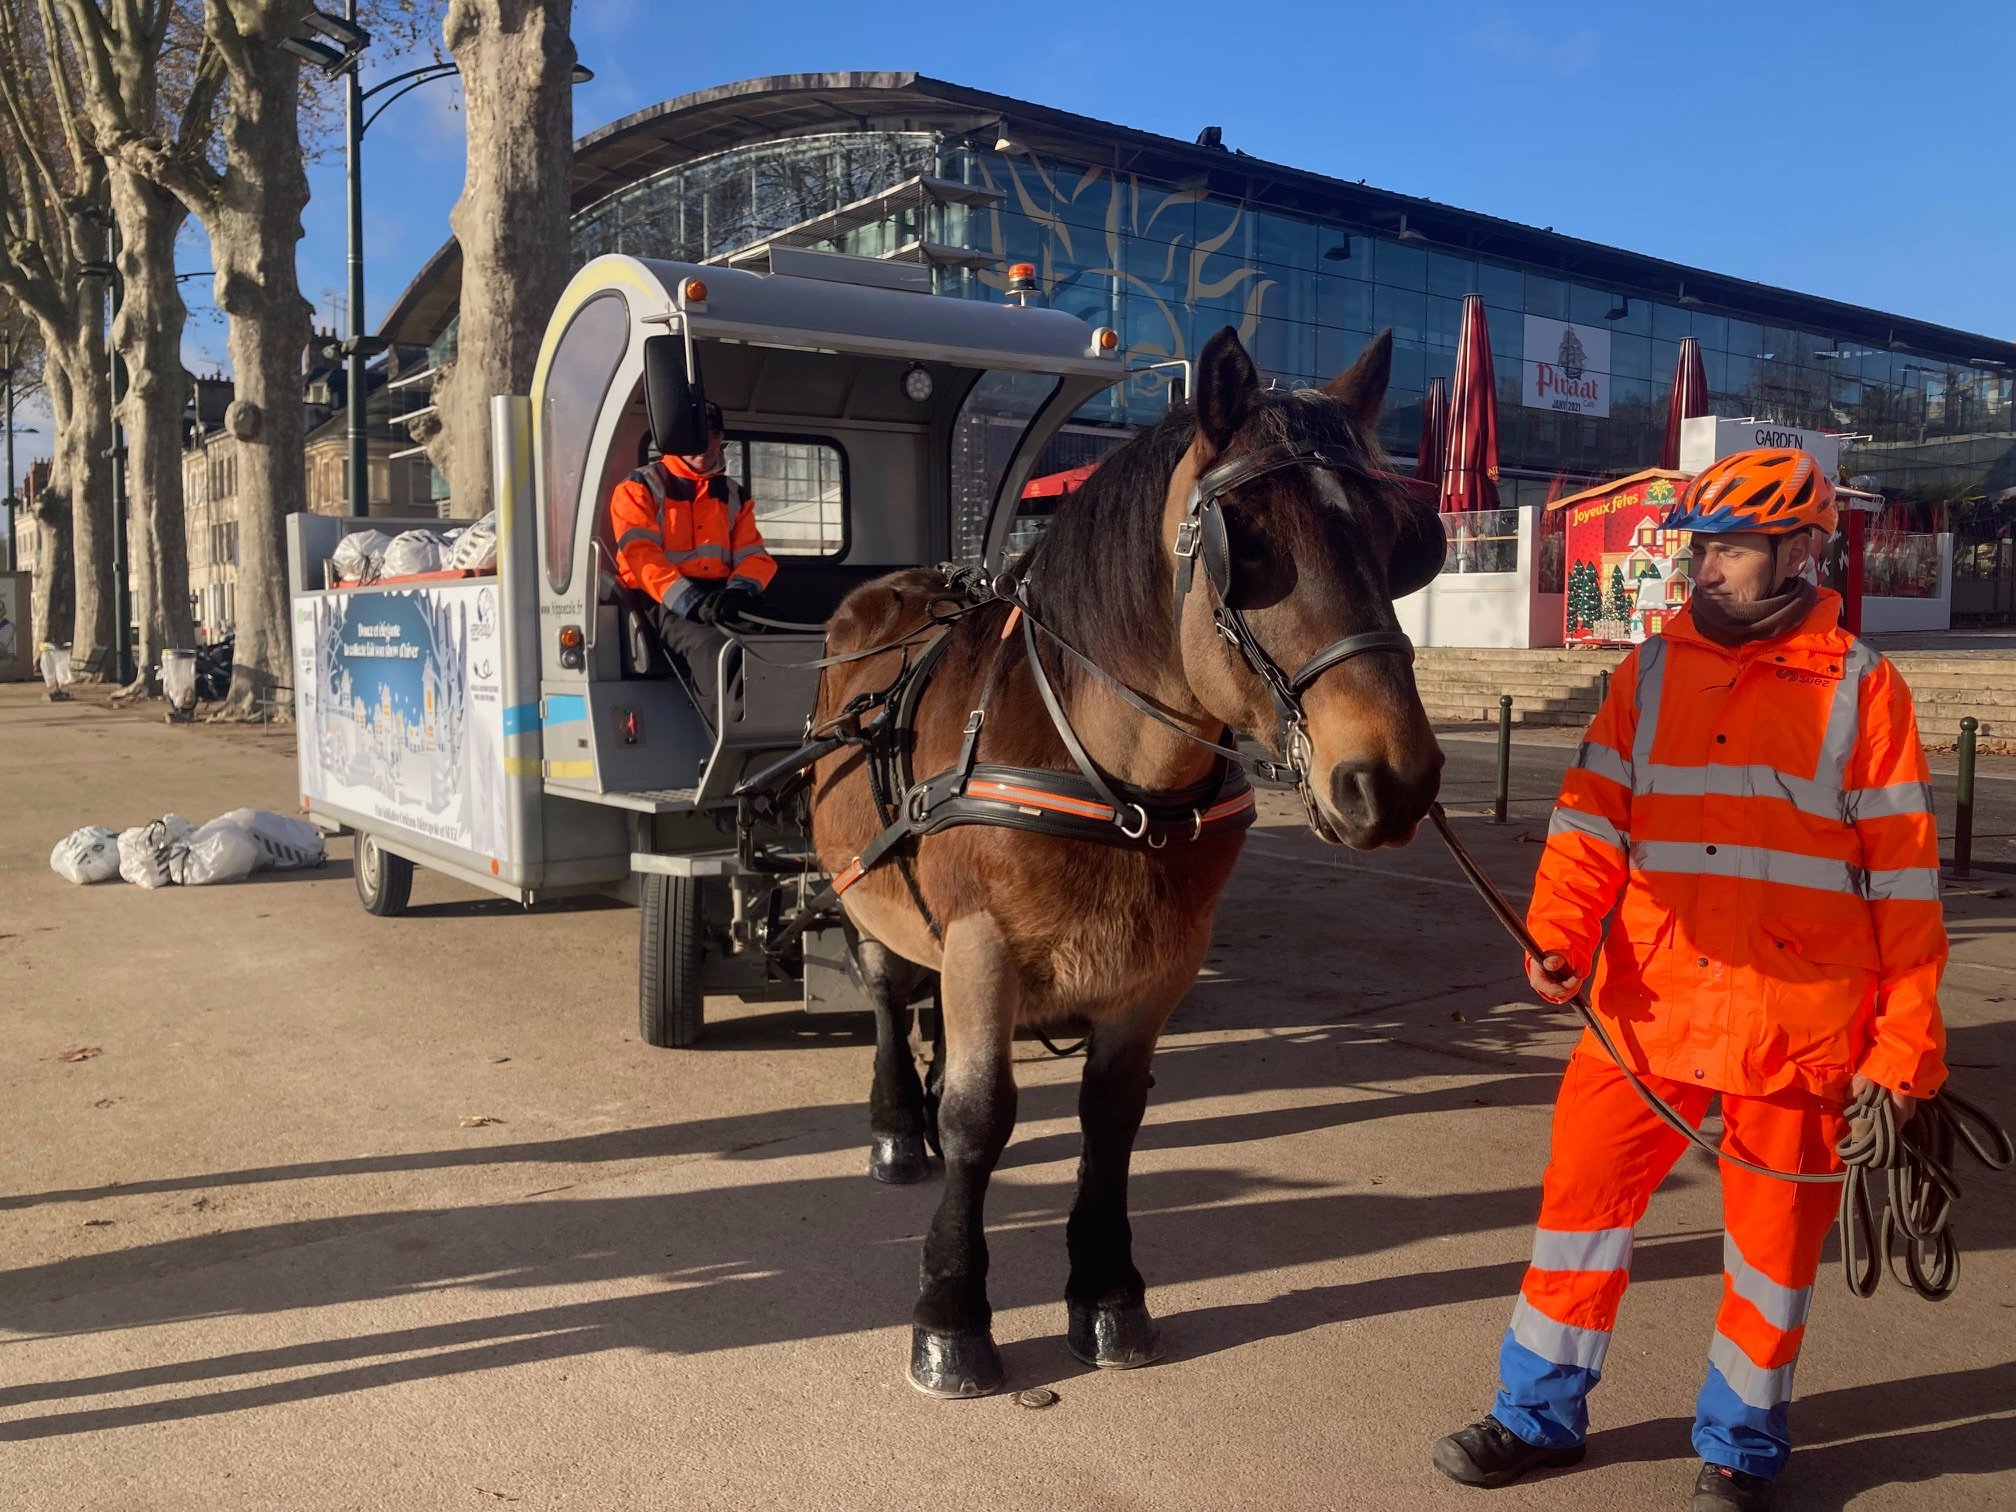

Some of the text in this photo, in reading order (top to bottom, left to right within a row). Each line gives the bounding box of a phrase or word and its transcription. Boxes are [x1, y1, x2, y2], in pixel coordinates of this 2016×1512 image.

[1536, 363, 1598, 401] Piraat
[1568, 401, 1581, 412] 2021
[1755, 429, 1803, 450] GARDEN
[1573, 493, 1639, 527] Joyeux fêtes
